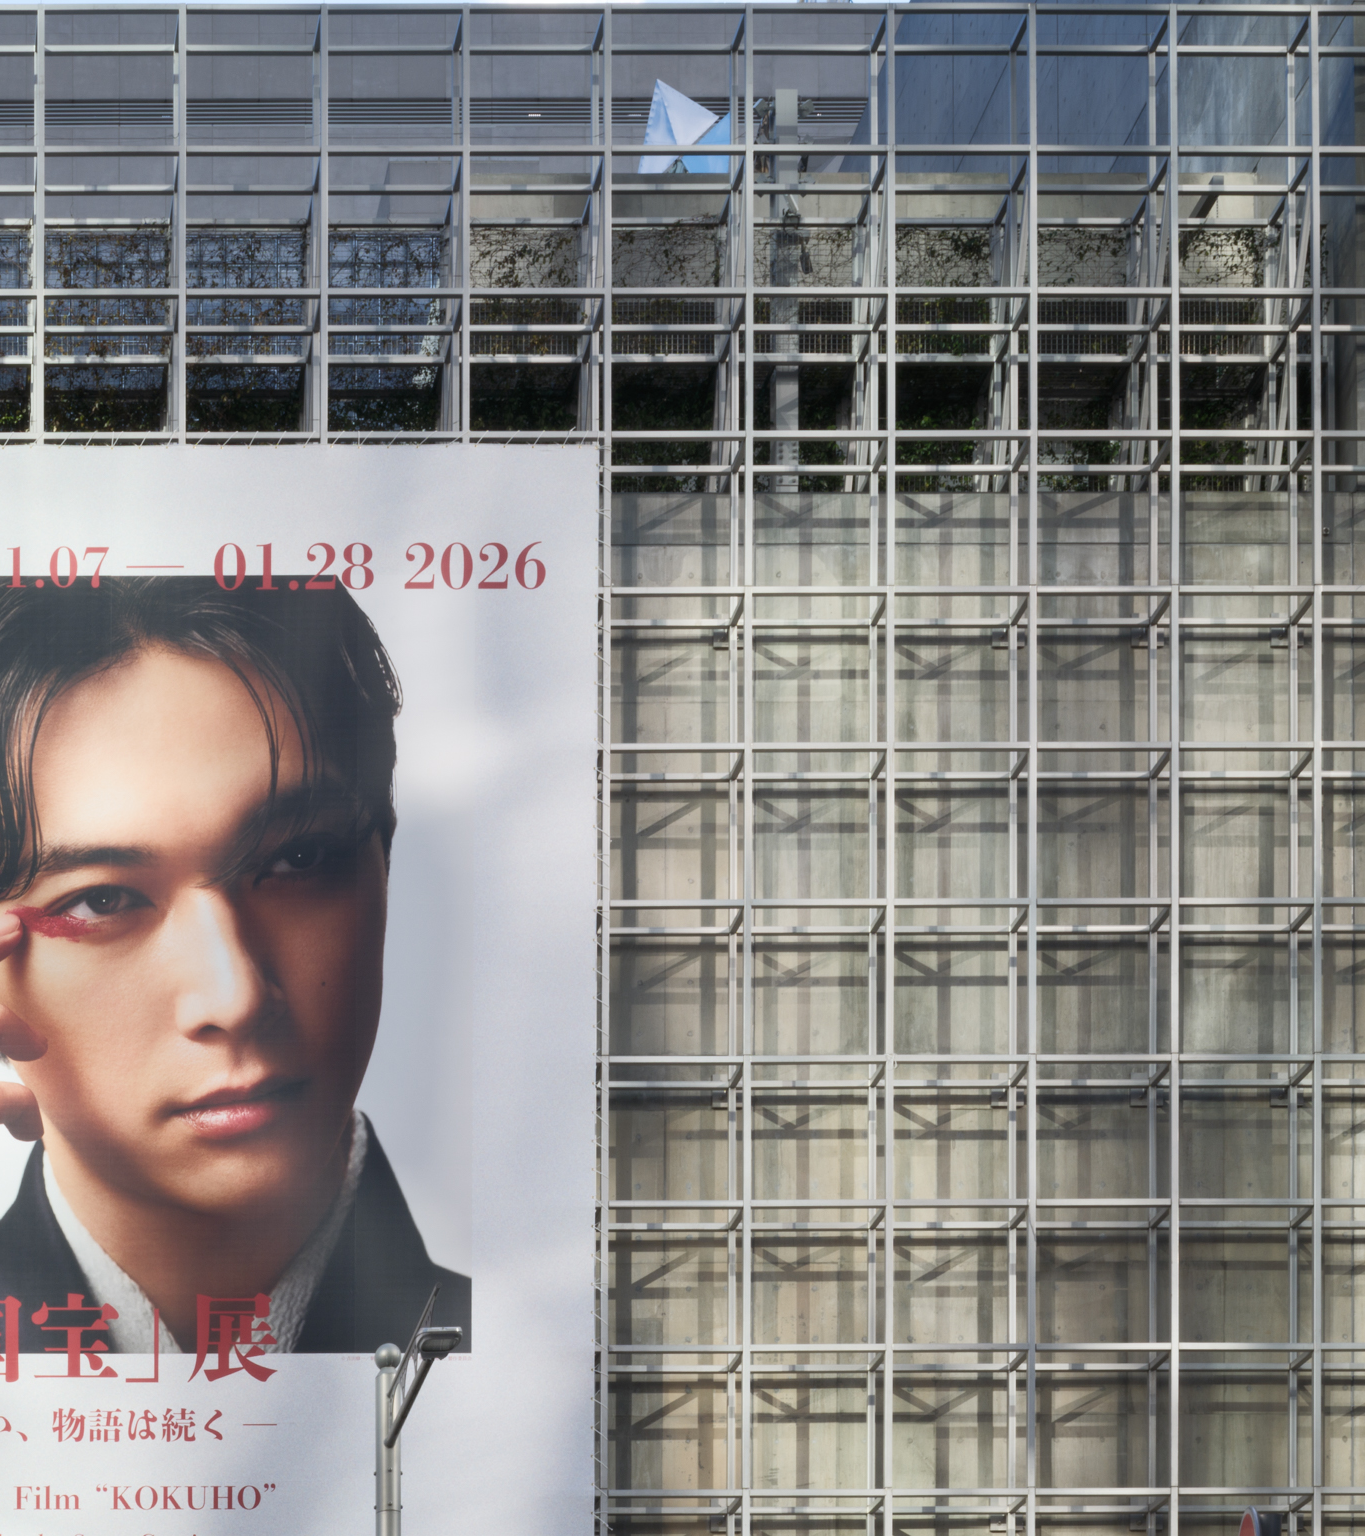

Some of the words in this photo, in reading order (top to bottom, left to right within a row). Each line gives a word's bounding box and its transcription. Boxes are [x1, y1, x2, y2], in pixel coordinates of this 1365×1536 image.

[213, 543, 375, 590] 01.28
[404, 541, 547, 590] 2026
[13, 1485, 81, 1511] Film
